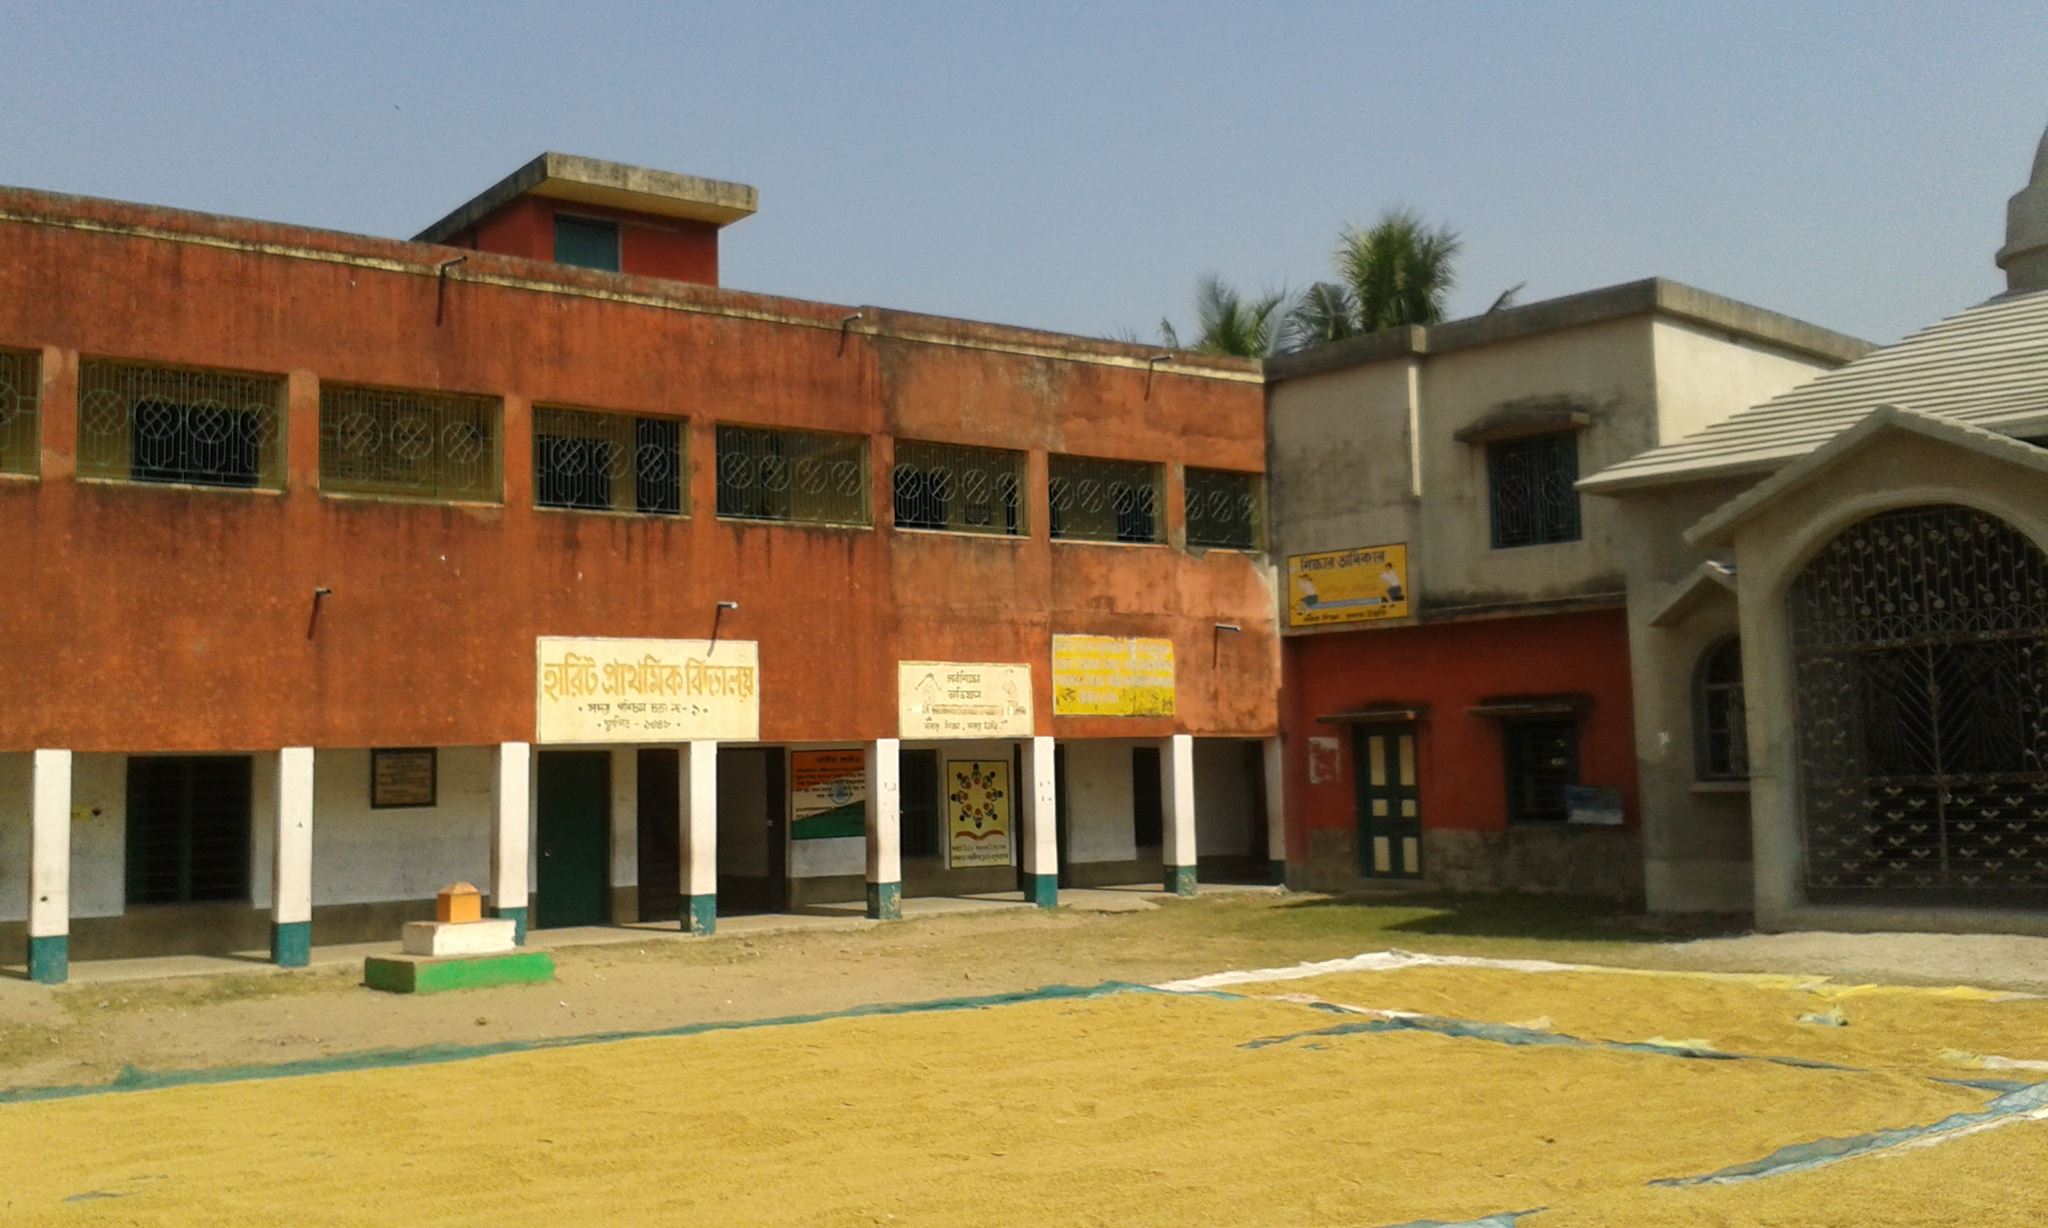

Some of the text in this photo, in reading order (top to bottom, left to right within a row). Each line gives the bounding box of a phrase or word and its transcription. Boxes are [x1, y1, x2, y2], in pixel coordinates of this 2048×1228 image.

[1337, 551, 1385, 568] অধিকার
[543, 652, 754, 703] হারিট প্রাথমিক বিদ্যালয়
[947, 686, 981, 700] অভিযান
